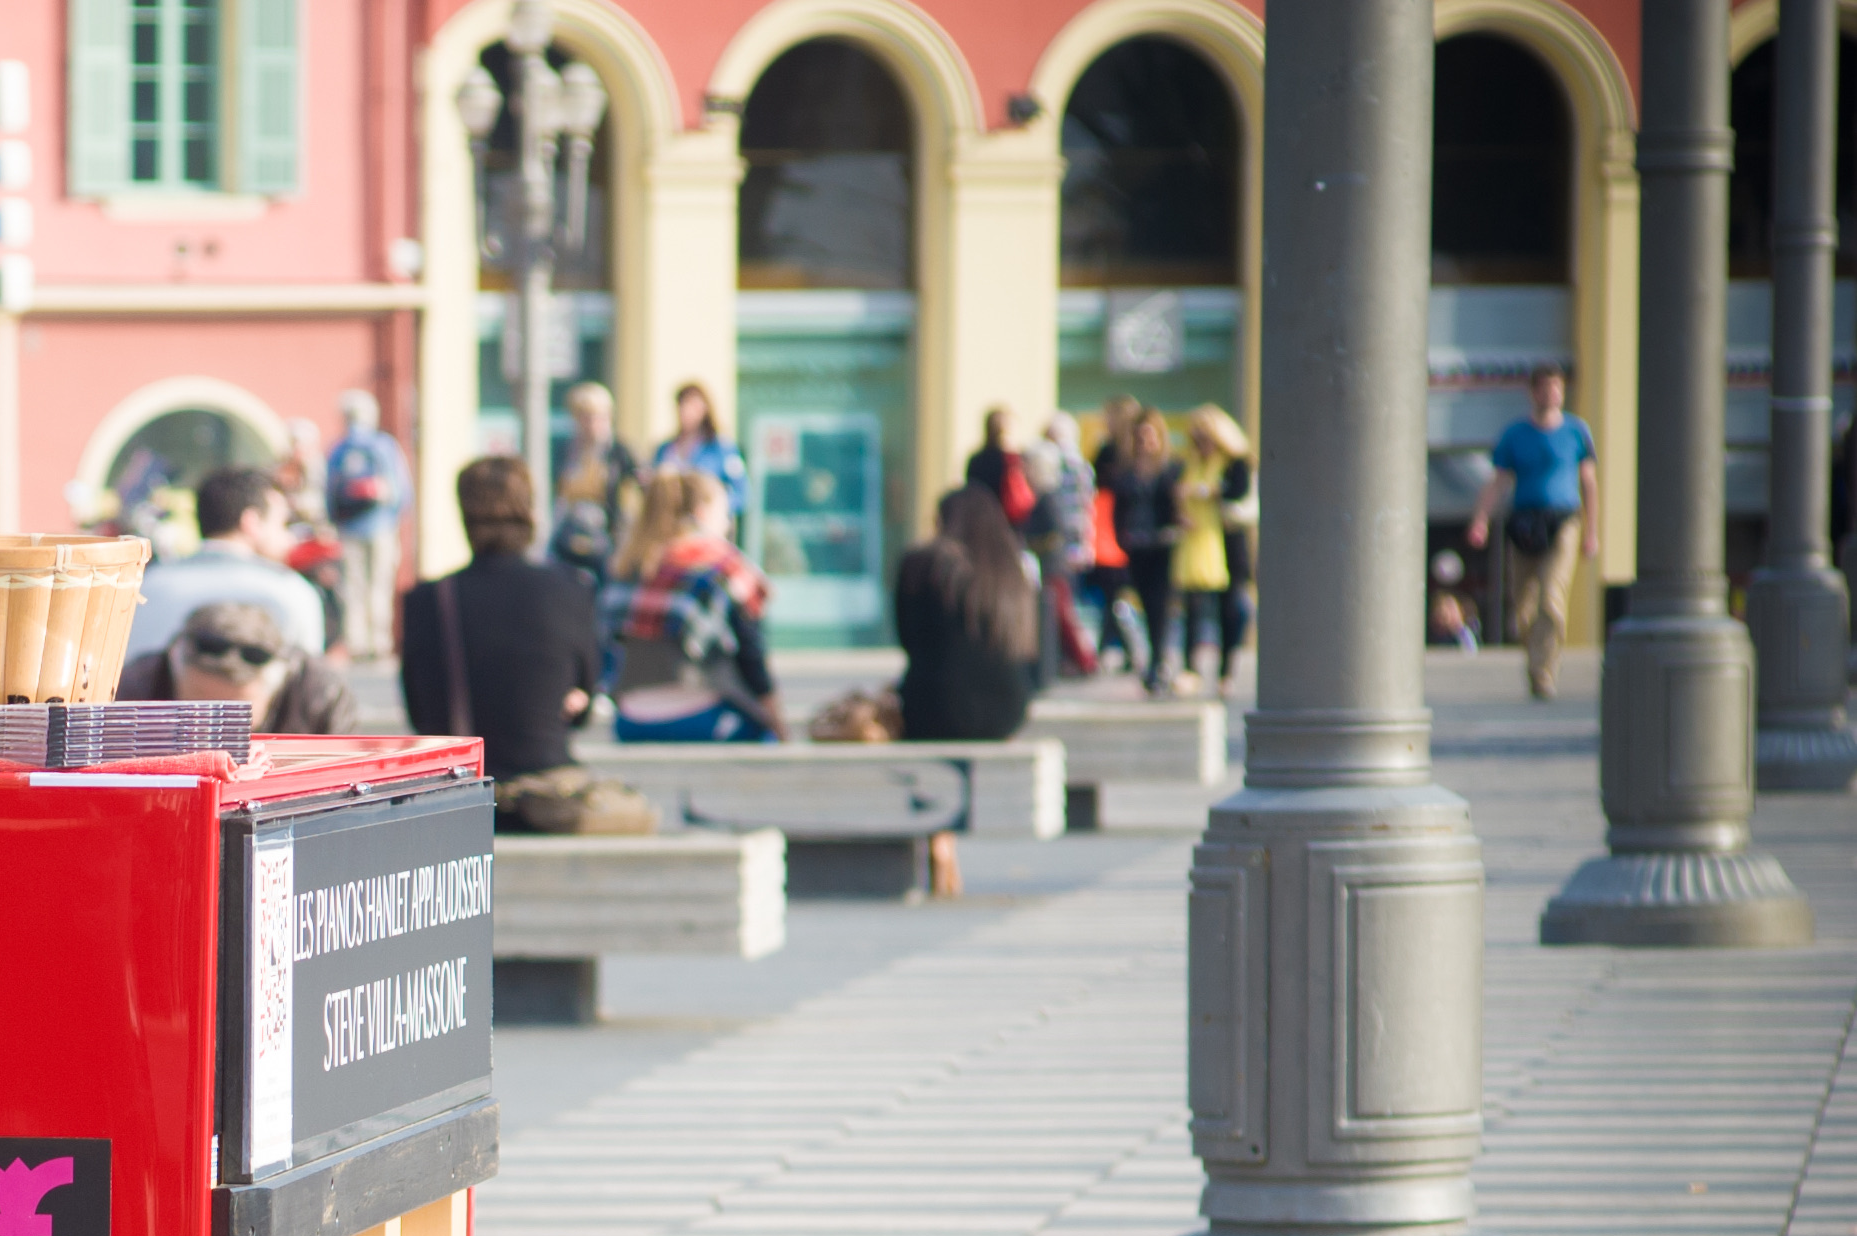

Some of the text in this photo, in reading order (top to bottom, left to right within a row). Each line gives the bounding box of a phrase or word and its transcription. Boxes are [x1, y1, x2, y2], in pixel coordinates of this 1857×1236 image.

[293, 853, 493, 962] LES PIANOS HANLET APPLAUDISSENT
[323, 957, 467, 1072] STEVE VILLA-MASSONE
